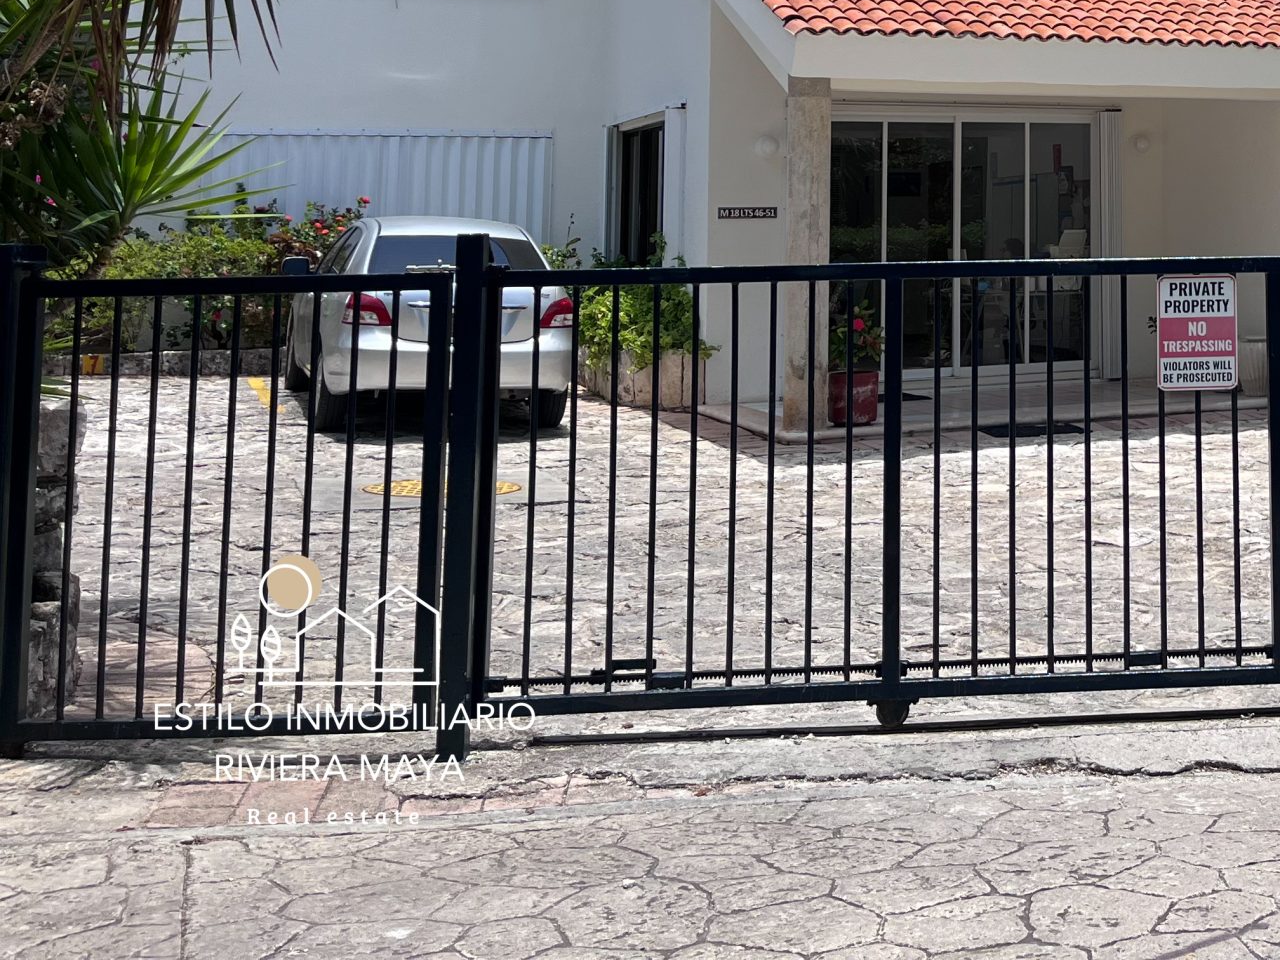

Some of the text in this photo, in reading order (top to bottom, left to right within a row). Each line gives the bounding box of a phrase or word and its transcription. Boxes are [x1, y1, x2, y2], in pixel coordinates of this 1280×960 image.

[720, 209, 775, 217] M 18 LTS 46-51
[1169, 281, 1225, 297] PRIVATE
[1164, 299, 1229, 313] PROPERTY
[1188, 321, 1207, 337] NO
[1163, 339, 1233, 353] TRESPASSING
[1163, 360, 1232, 372] VIOLATORS WILL
[1163, 372, 1233, 384] BE PROSECUTED
